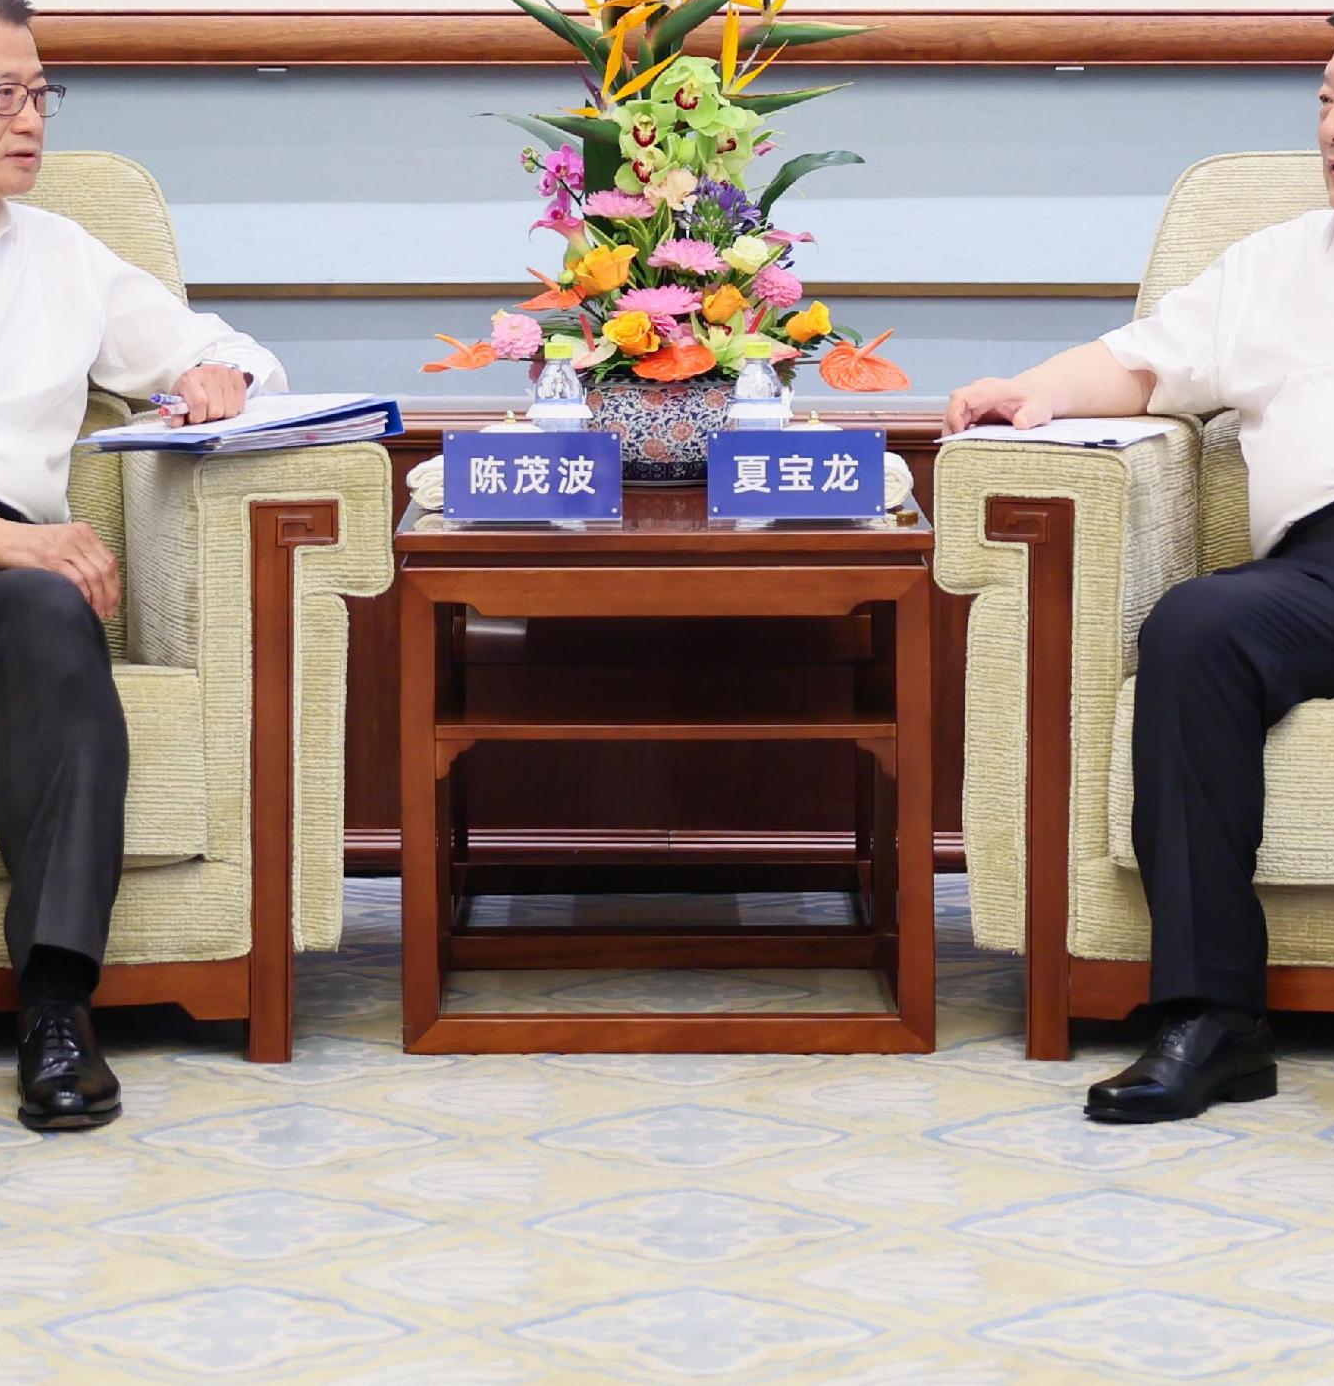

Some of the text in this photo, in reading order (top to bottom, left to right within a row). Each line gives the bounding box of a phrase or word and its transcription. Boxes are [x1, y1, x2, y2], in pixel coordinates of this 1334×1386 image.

[471, 456, 595, 494] 陈茂波
[734, 454, 858, 493] 夏宝龙
